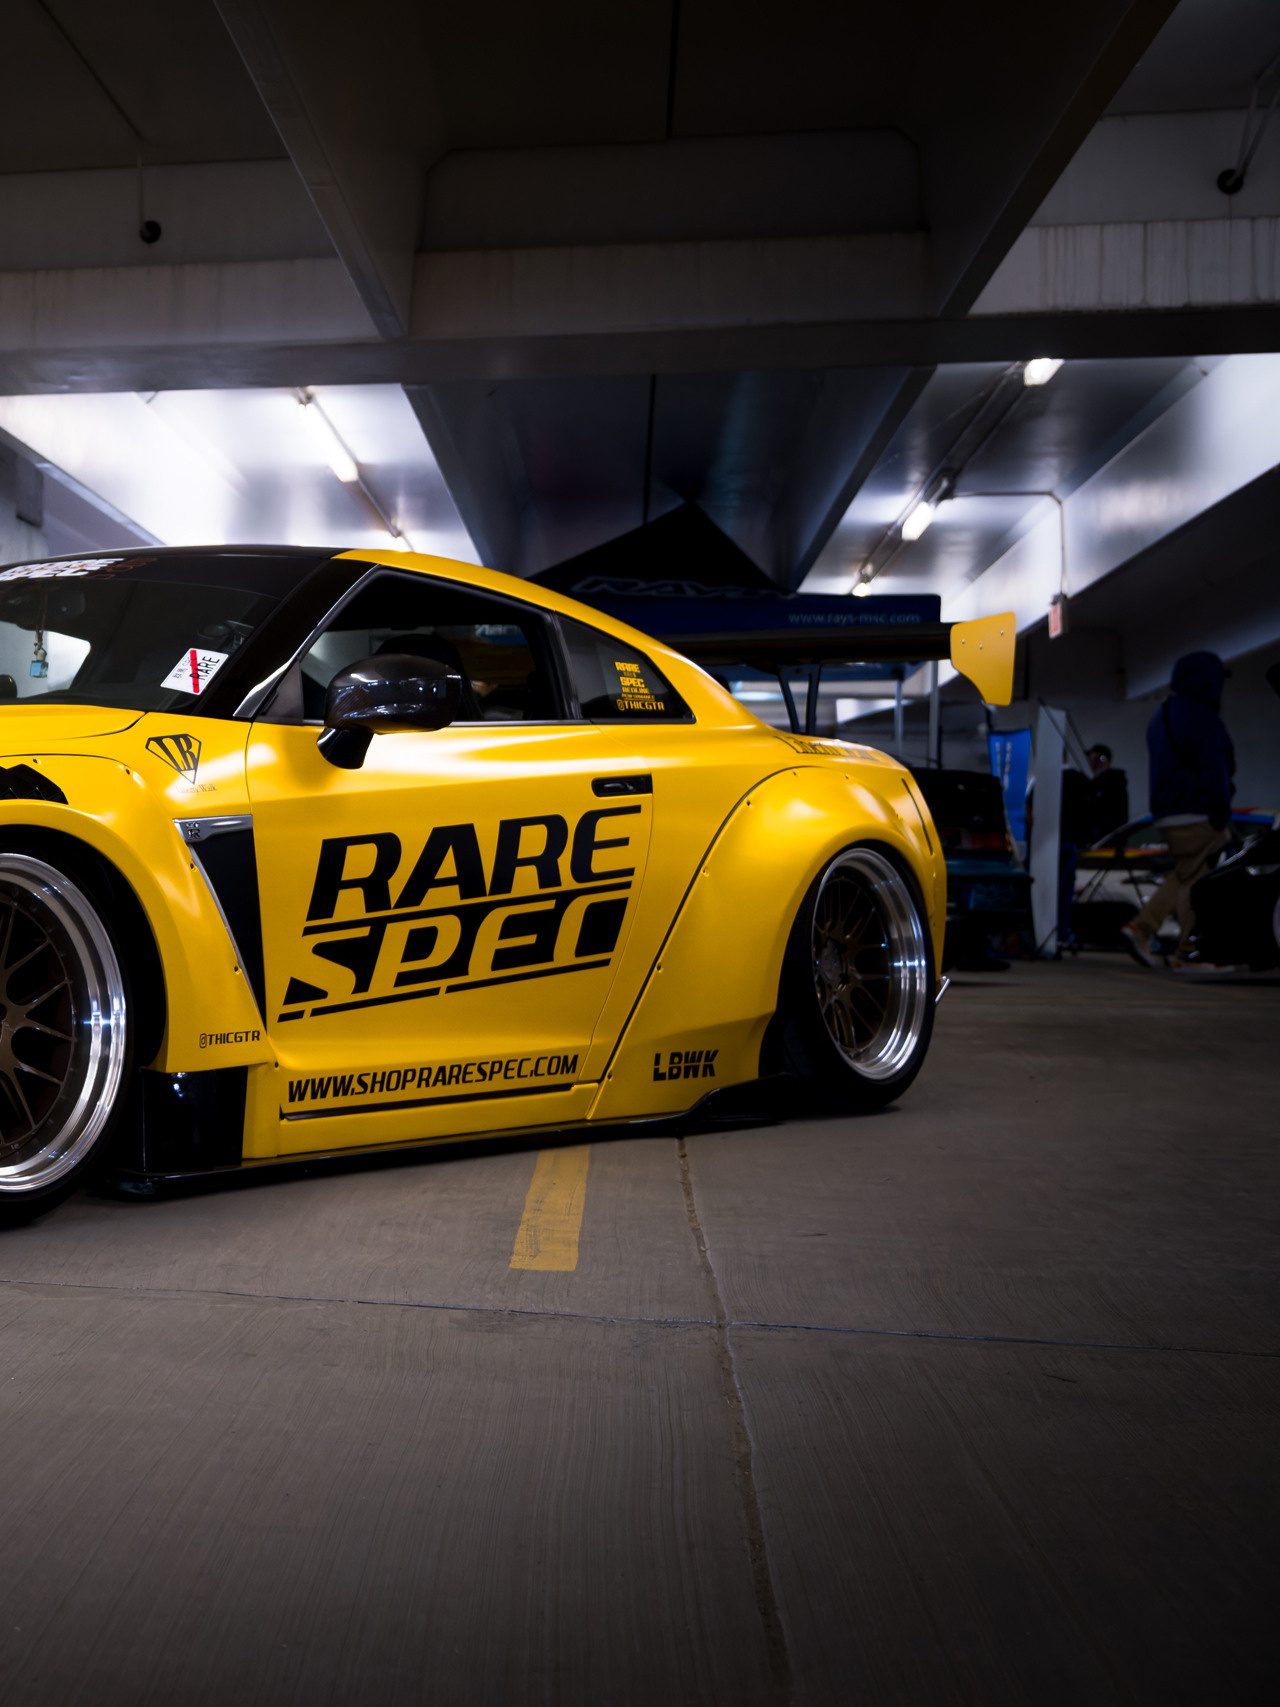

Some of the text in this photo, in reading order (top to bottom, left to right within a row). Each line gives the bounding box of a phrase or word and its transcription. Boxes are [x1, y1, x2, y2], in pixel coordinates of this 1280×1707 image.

[614, 661, 641, 673] RARE
[620, 676, 645, 688] SPEC
[306, 804, 642, 922] RARE
[277, 889, 629, 1008] SPEC
[199, 1030, 261, 1048] @THICGTR
[288, 1055, 579, 1102] WWW.SHOPRARESPEC.COM
[653, 1050, 719, 1081] LBWK
